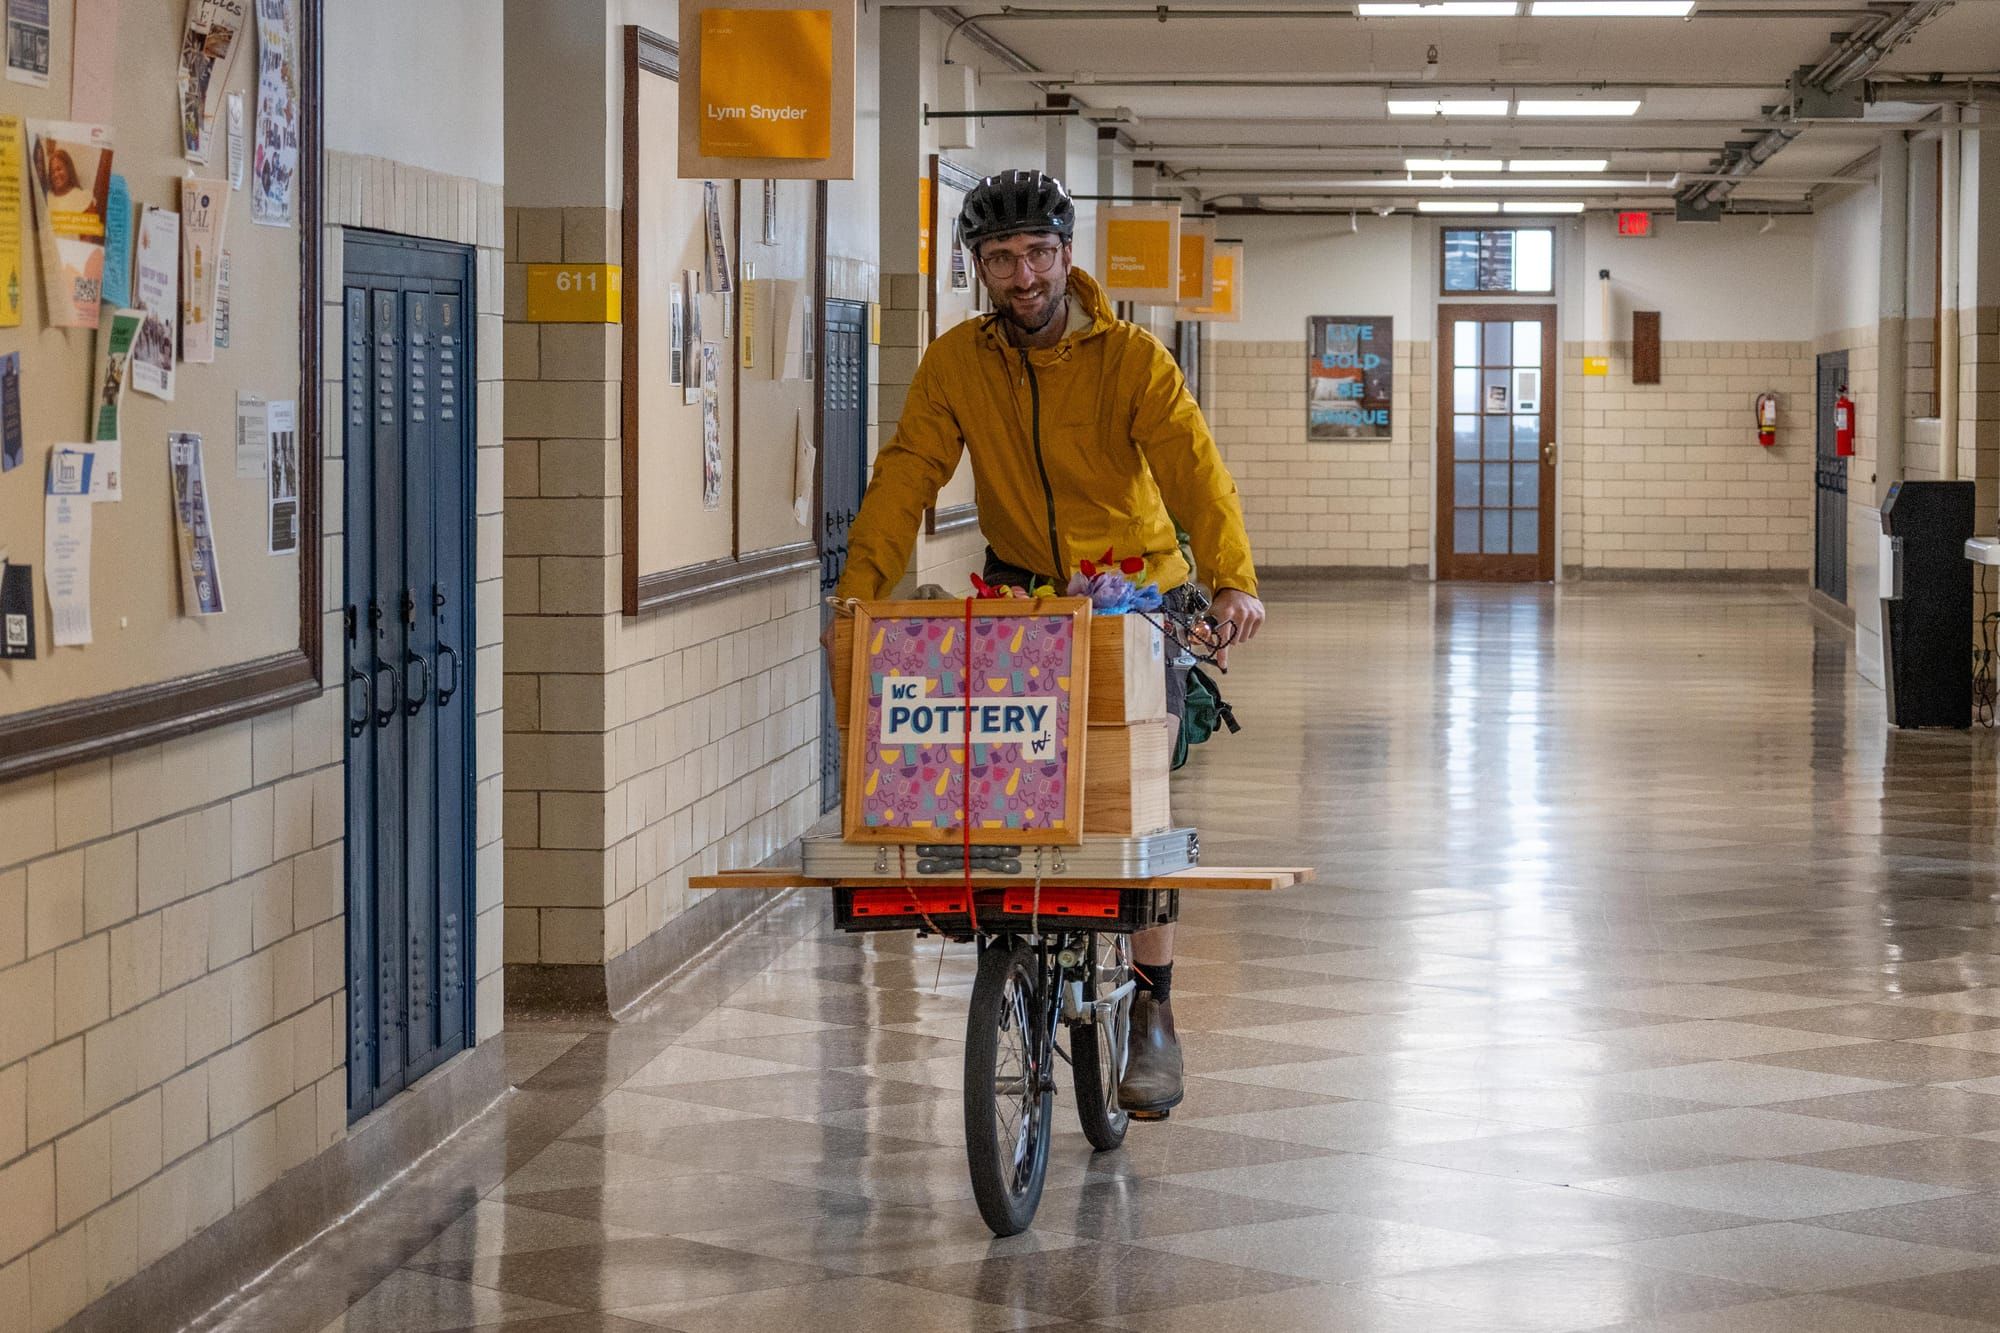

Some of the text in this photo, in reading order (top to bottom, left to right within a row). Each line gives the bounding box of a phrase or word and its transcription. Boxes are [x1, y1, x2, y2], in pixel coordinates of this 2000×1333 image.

[707, 103, 808, 122] Lynn Snyder
[1618, 212, 1649, 236] EXIT
[556, 271, 597, 292] 611
[1327, 325, 1374, 341] LIVE
[1322, 353, 1381, 369] BOLD
[1337, 383, 1365, 398] BE
[1311, 409, 1389, 426] UNIQUE
[892, 683, 918, 700] WC
[889, 704, 1049, 734] POTTERY
